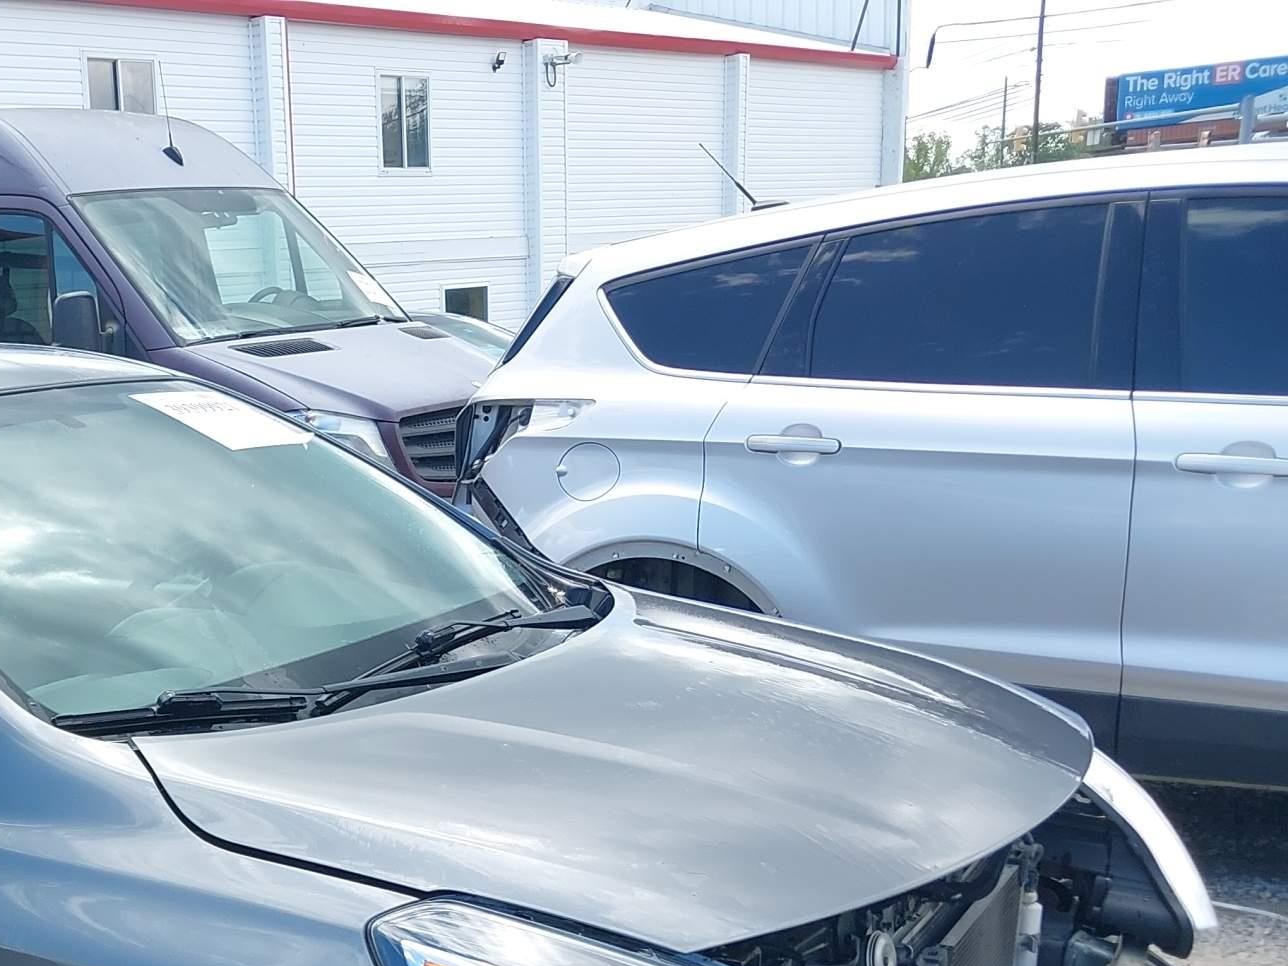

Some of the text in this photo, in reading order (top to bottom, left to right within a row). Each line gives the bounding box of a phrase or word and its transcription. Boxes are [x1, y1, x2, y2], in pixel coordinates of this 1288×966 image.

[1125, 62, 1288, 93] The Right ER Care
[1124, 92, 1195, 110] Right Away
